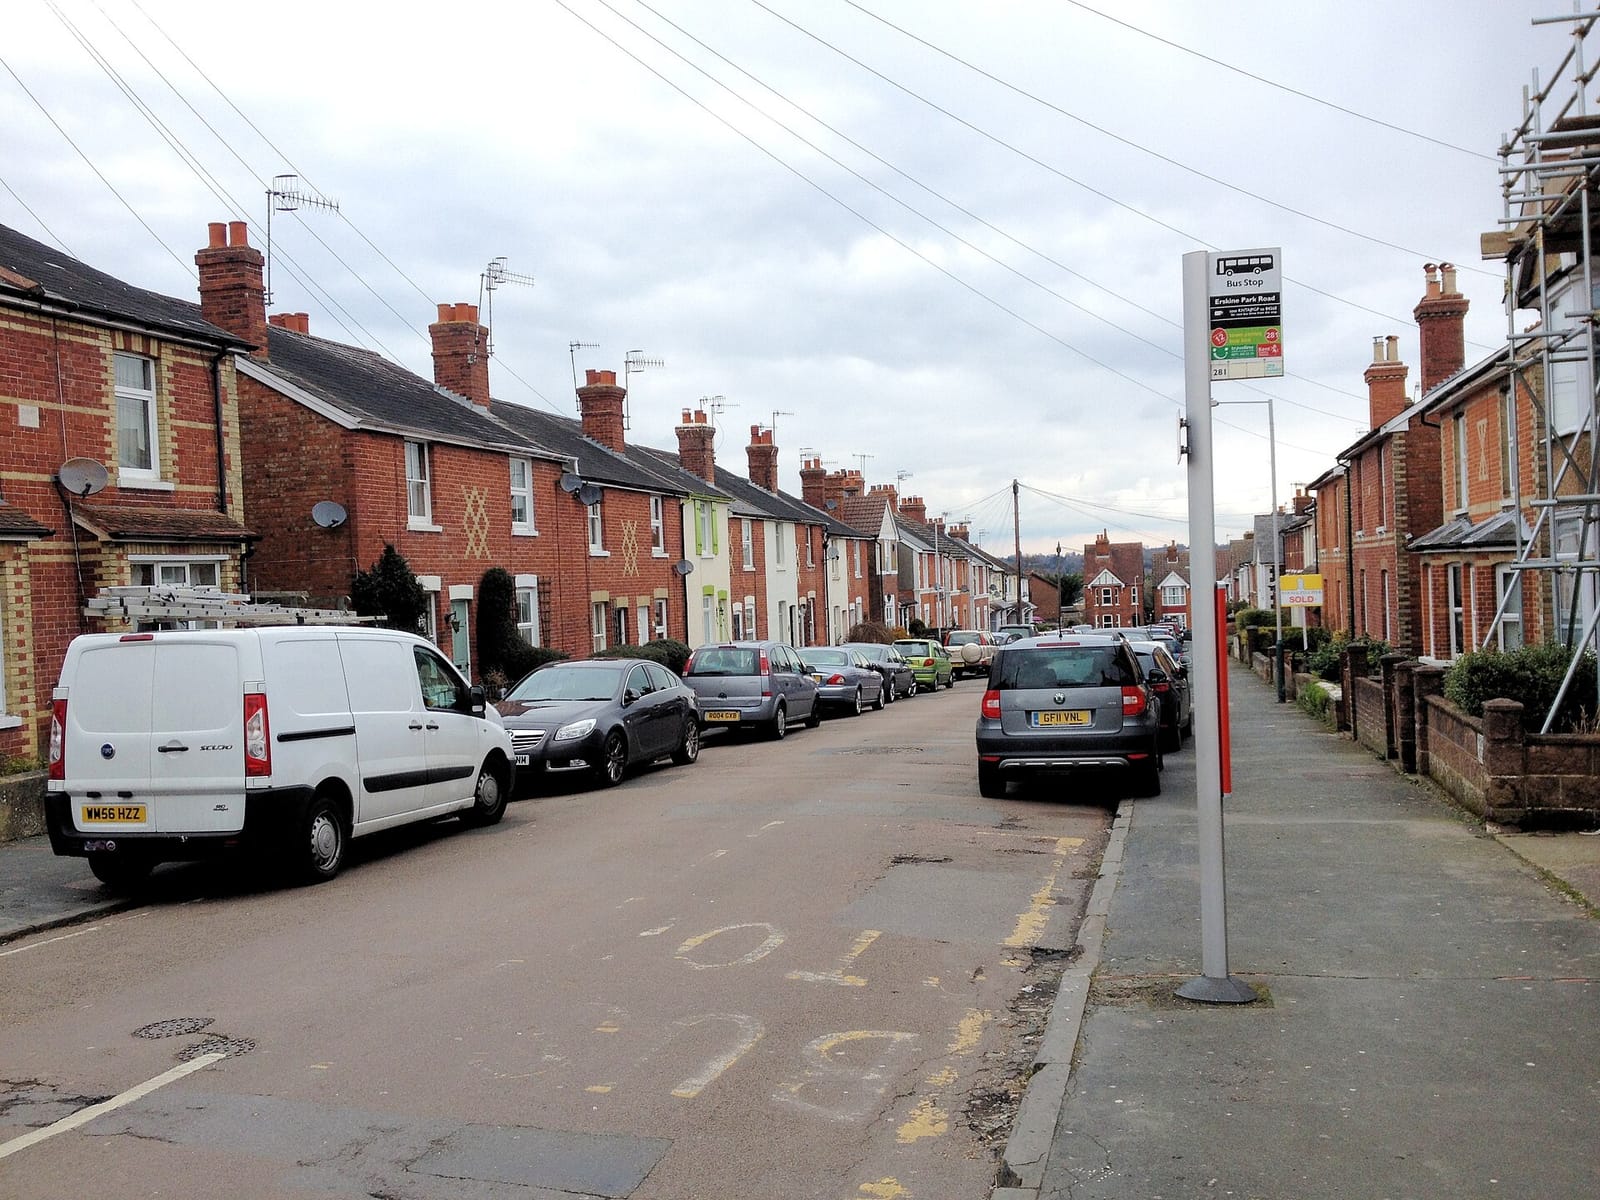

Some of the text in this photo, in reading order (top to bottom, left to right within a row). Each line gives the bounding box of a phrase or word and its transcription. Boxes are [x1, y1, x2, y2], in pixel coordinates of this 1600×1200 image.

[1244, 279, 1264, 288] Stop
[1257, 295, 1276, 303] Road
[1044, 713, 1082, 722] GF11 VNL
[86, 807, 141, 820] WM56 HZZ
